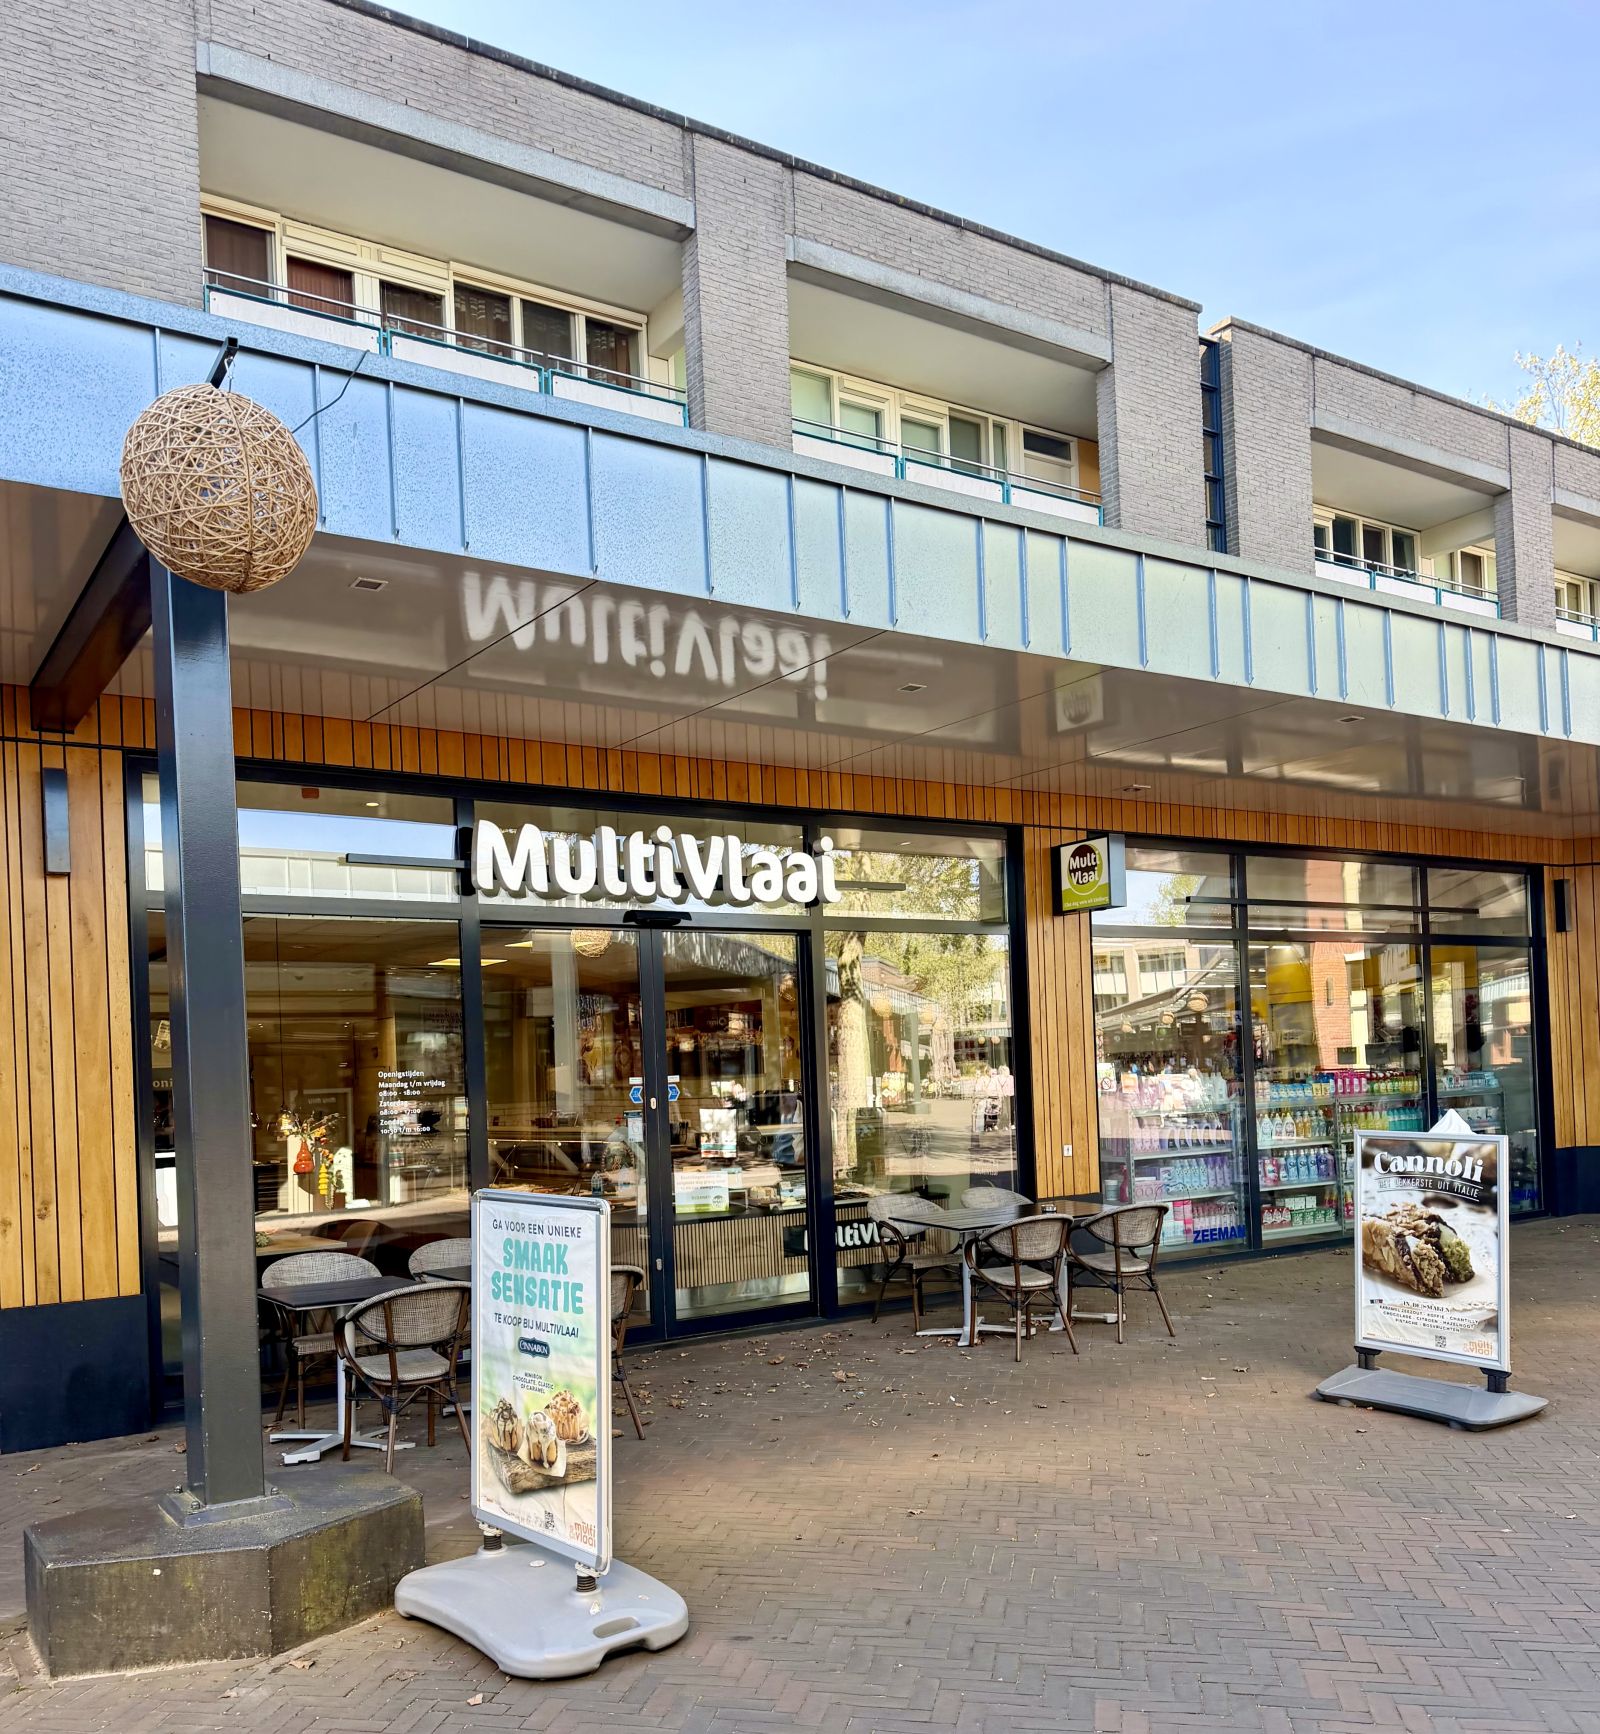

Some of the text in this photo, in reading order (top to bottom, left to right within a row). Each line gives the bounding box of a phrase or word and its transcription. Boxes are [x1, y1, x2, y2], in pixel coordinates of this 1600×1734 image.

[472, 819, 841, 903] MultiVlaai
[1069, 851, 1100, 870] Multi
[1070, 867, 1100, 885] Vlaai
[423, 1080, 446, 1088] vrijdag
[1374, 1151, 1484, 1183] Cannoli
[1437, 1181, 1449, 1191] UIT
[492, 1219, 581, 1238] GA VOOR EEN UNIEKE
[1193, 1225, 1246, 1244] ZEEMAN
[503, 1237, 568, 1275] SMAAK
[491, 1271, 584, 1314] SENSATIE
[494, 1312, 502, 1323] TE
[503, 1315, 522, 1327] KOOP
[523, 1318, 534, 1329] BIJ
[520, 1340, 548, 1354] CINNABON
